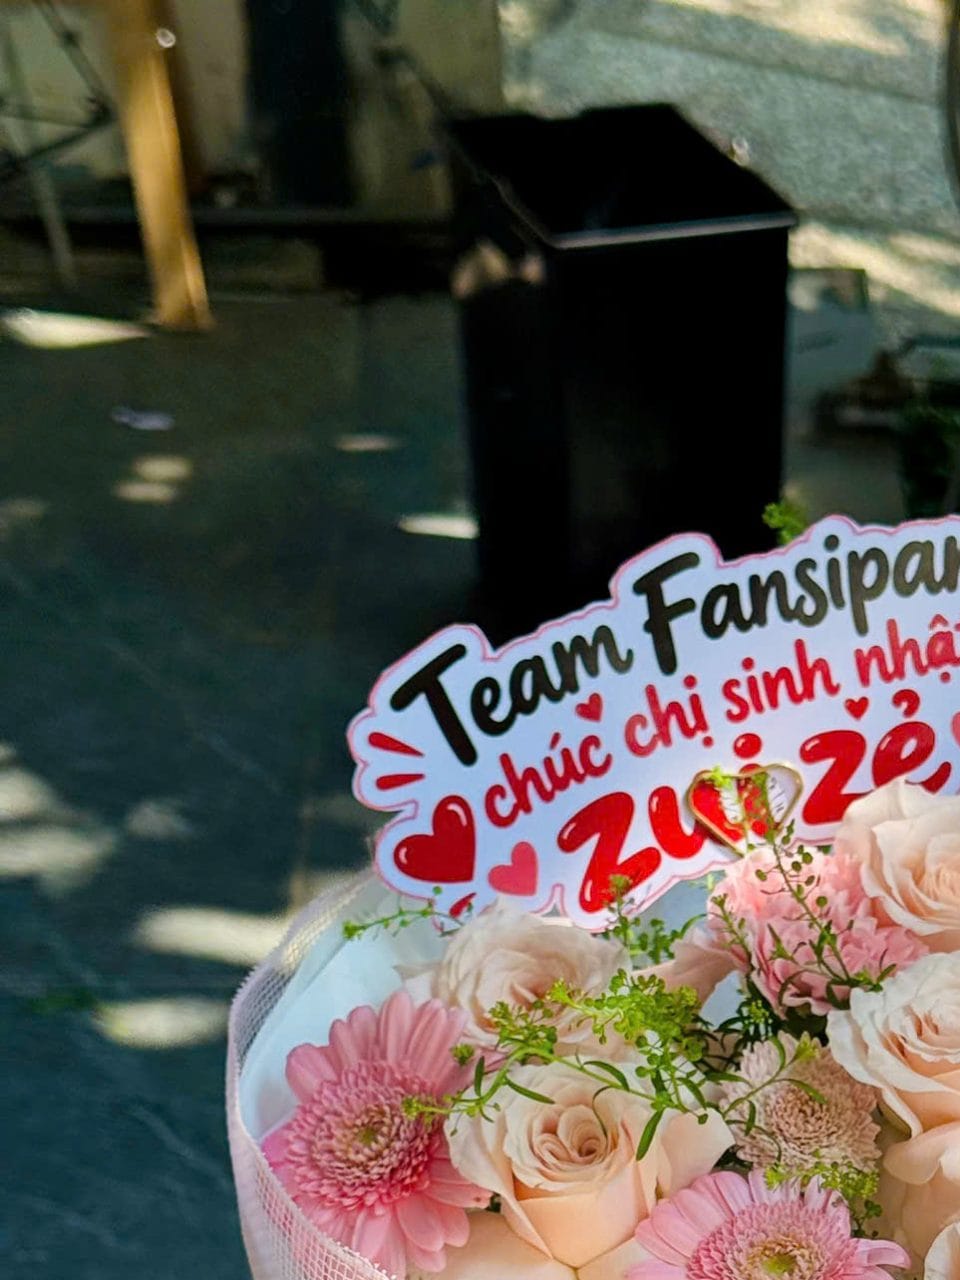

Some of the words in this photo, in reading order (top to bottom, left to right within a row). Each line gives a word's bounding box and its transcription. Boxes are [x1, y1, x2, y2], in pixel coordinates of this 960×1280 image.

[390, 625, 633, 767] Team
[484, 732, 613, 828] chúc
[624, 675, 714, 758] chị
[721, 638, 840, 723] sinh
